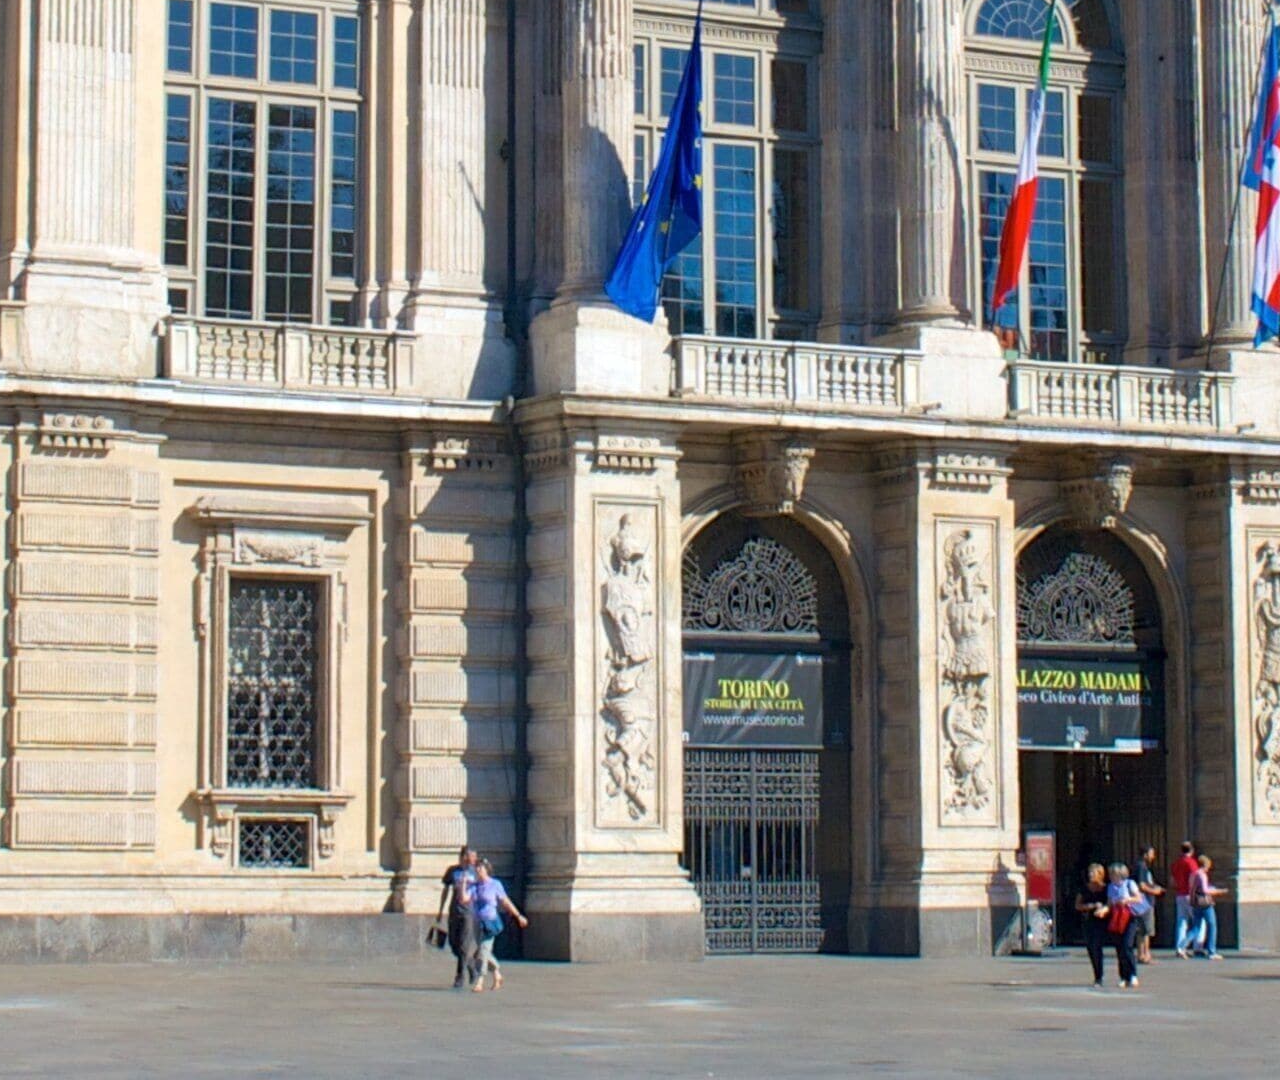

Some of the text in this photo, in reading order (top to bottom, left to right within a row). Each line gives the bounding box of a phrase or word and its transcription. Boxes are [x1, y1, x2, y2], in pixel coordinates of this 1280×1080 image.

[717, 678, 790, 699] TORINO
[703, 698, 738, 710] STORIA
[740, 699, 751, 710] DI
[1040, 690, 1076, 705] Civico
[1078, 691, 1113, 706] d'Arte
[703, 714, 805, 727] www.museotorino.it
